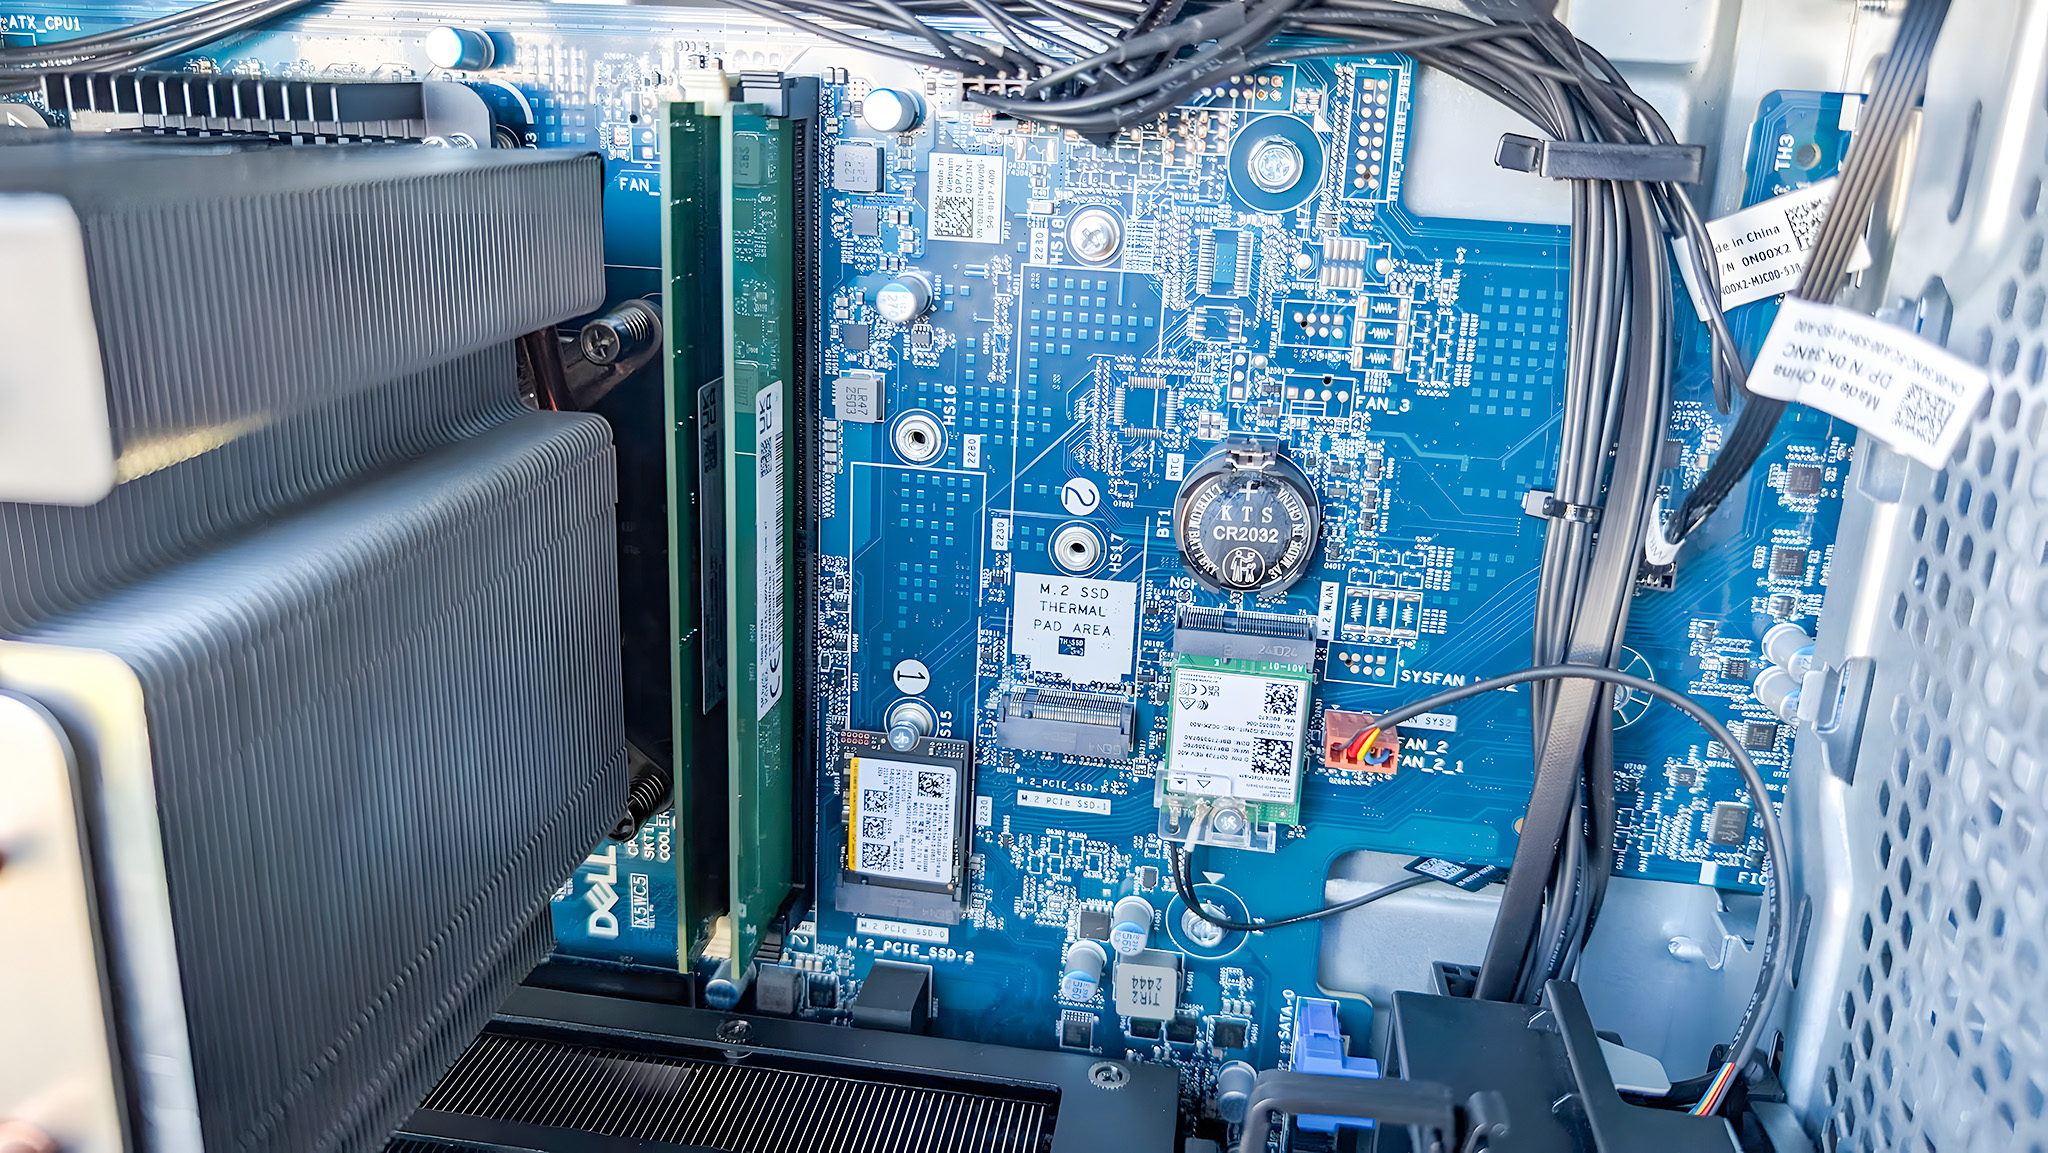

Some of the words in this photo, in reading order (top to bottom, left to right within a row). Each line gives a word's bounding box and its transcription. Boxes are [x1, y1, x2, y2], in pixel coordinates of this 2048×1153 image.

[9, 15, 81, 33] ATX_CPU1
[1774, 133, 1795, 171] TH3
[619, 177, 661, 196] FAN_
[1052, 218, 1064, 262] HS18
[1746, 225, 1780, 243] China
[1773, 363, 1817, 385] China
[856, 386, 868, 417] LR47
[944, 385, 956, 426] HS16
[1355, 396, 1411, 415] FAN_3
[967, 438, 977, 464] 2280
[1169, 457, 1180, 478] RTC
[1065, 489, 1096, 507] 2
[995, 521, 1005, 547] 2230
[1156, 509, 1171, 538] BT1
[1213, 526, 1279, 543] CR2032
[1109, 533, 1123, 572] HS17
[1267, 560, 1283, 579] 3V
[1281, 540, 1303, 569] MADE
[1292, 522, 1305, 537] IN
[1040, 584, 1069, 596] M.2
[1080, 587, 1109, 599] SSD
[1040, 601, 1106, 617] THERMAL
[1034, 619, 1062, 632] PAD
[1073, 623, 1111, 636] AREA
[1425, 717, 1452, 727] SYS2
[1017, 776, 1108, 793] M.2_PCIE_SSD-
[980, 799, 989, 822] 2230
[1047, 796, 1071, 806] PCIe
[585, 845, 620, 940] DELL
[846, 936, 975, 964] M.2_PCIE_SSD-2
[1131, 976, 1162, 991] 2444
[1278, 989, 1296, 1039] SATA-0
